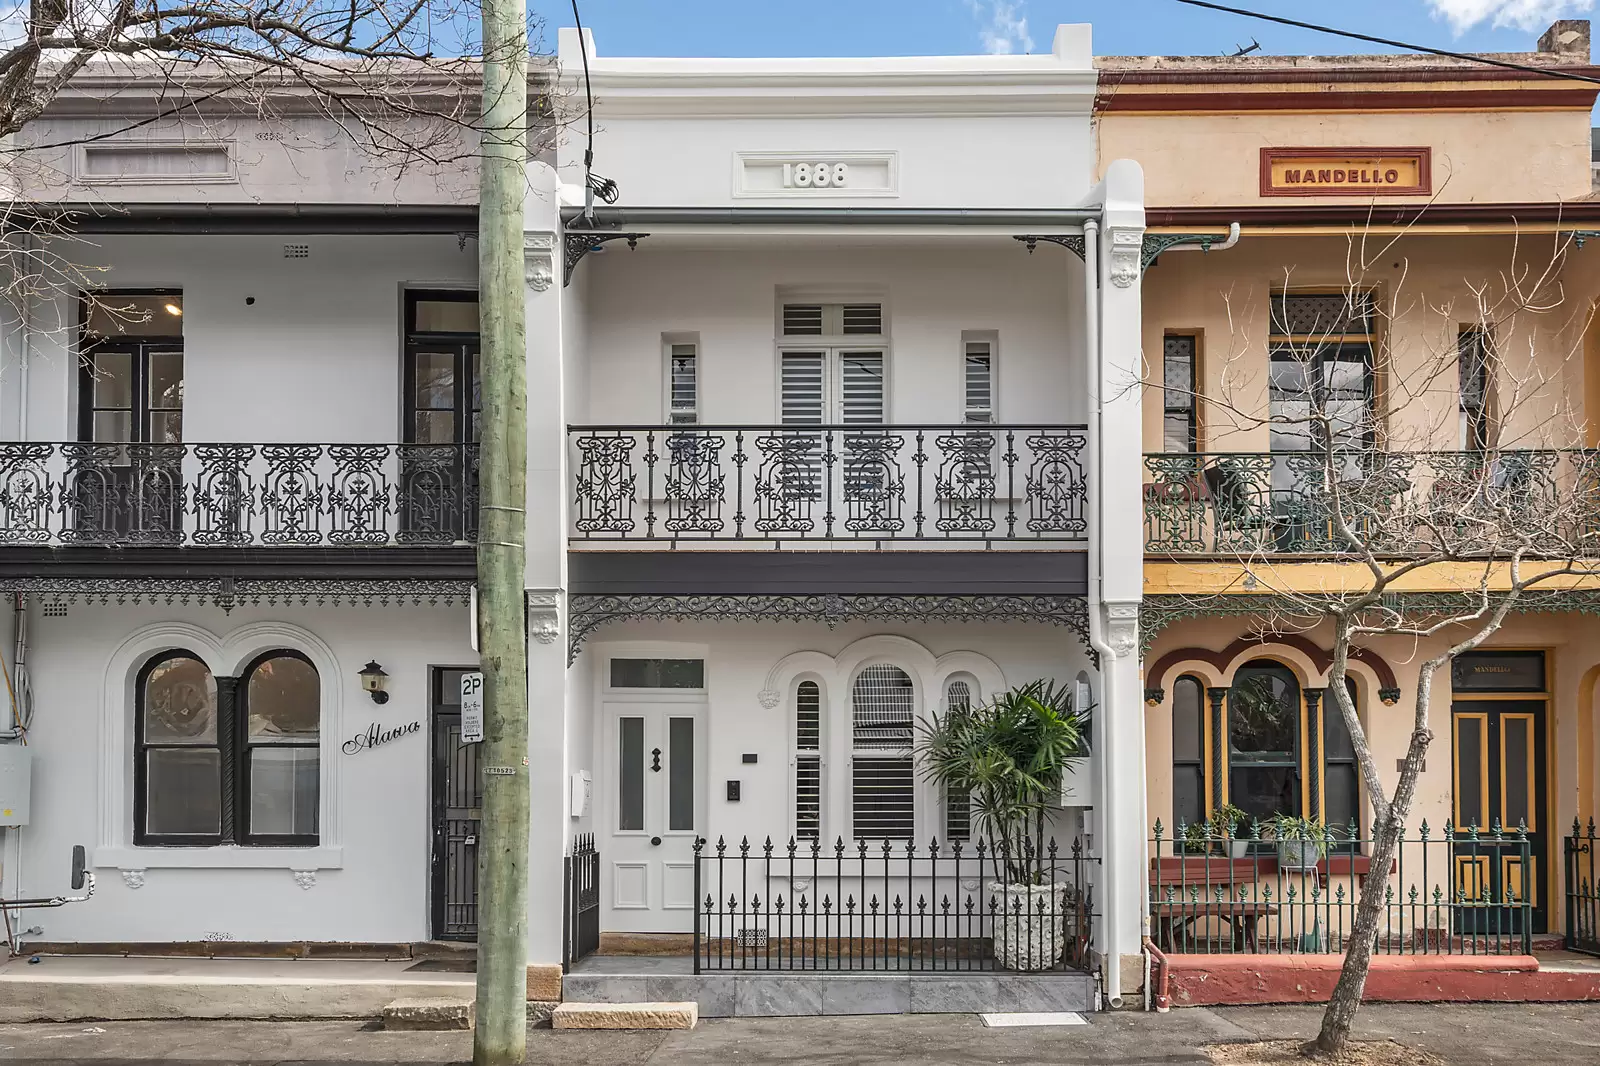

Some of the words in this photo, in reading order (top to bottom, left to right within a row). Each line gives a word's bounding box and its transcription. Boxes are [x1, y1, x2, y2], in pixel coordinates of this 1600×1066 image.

[783, 162, 849, 188] 1888
[1285, 169, 1399, 183] MANDELLO
[463, 678, 481, 695] 2P
[342, 721, 420, 755] Alawa
